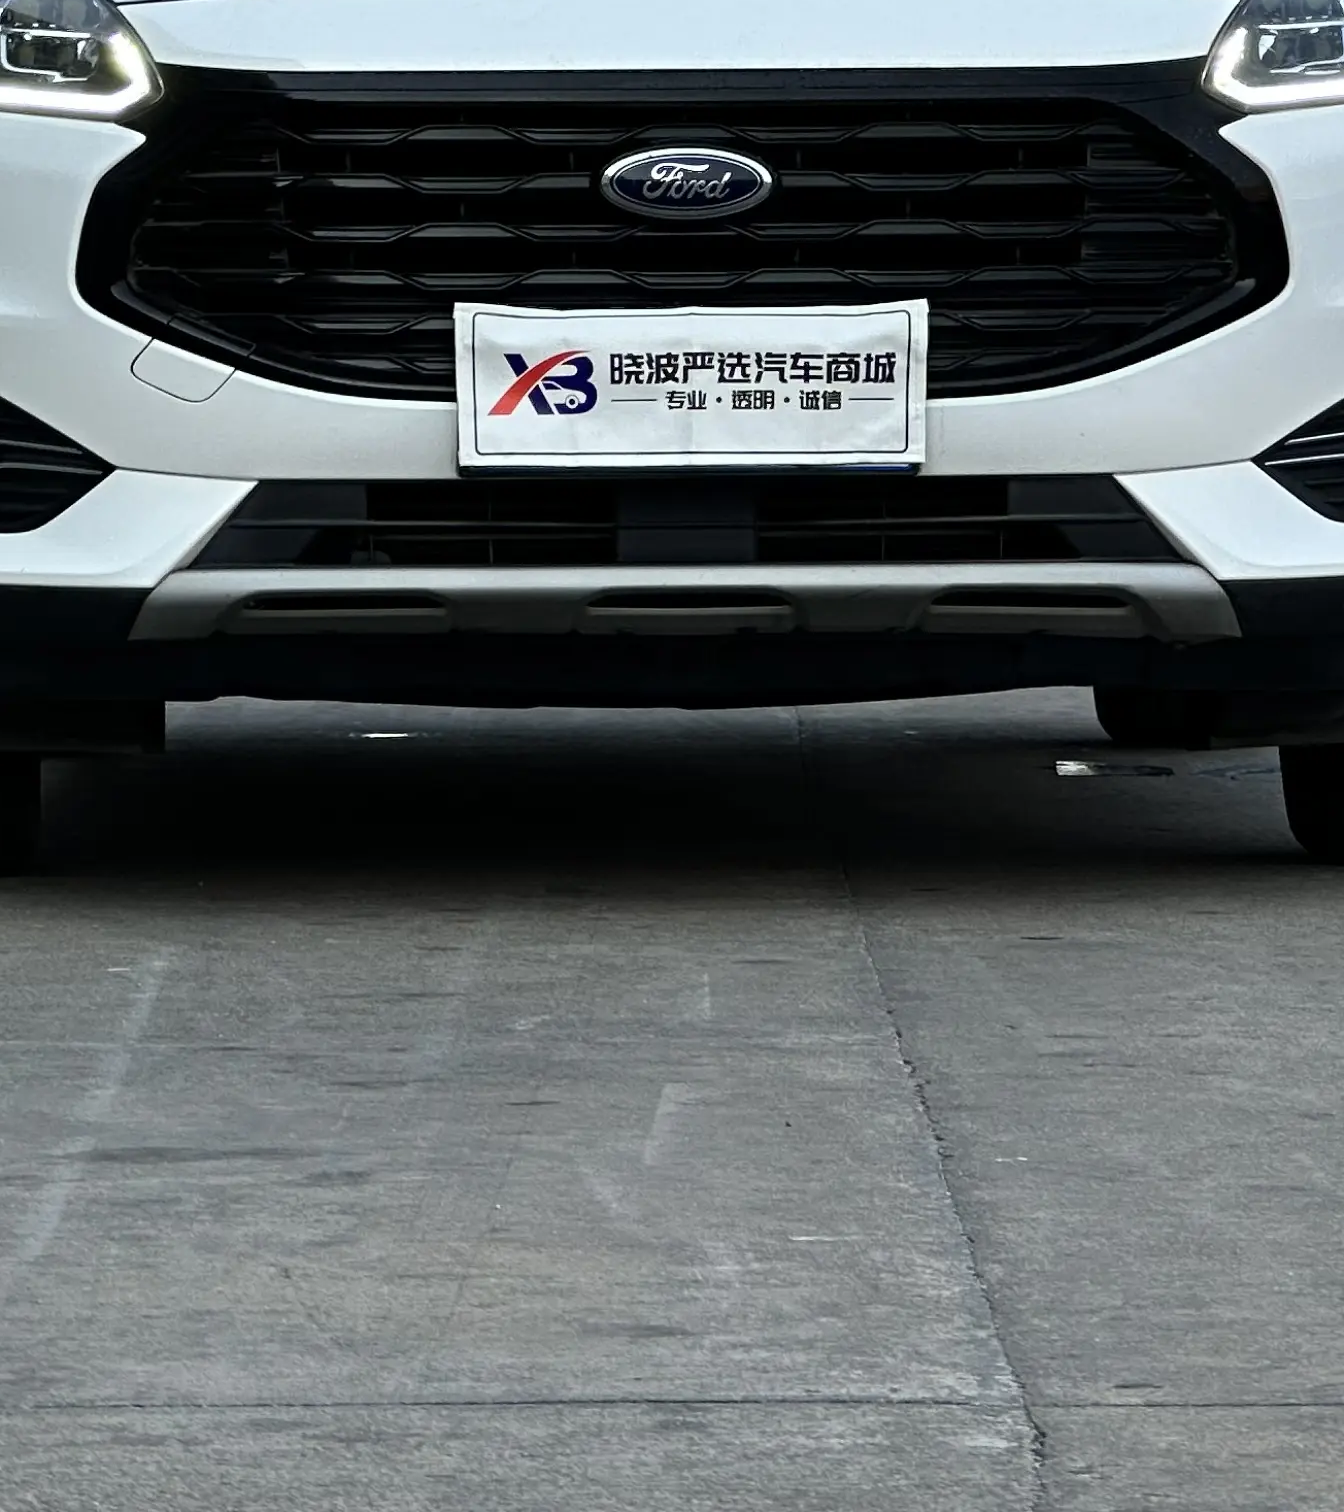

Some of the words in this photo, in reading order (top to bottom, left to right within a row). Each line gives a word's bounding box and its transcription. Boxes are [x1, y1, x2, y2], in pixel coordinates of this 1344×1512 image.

[642, 162, 732, 199] Ford
[609, 351, 897, 385] 晓波严选汽车商城
